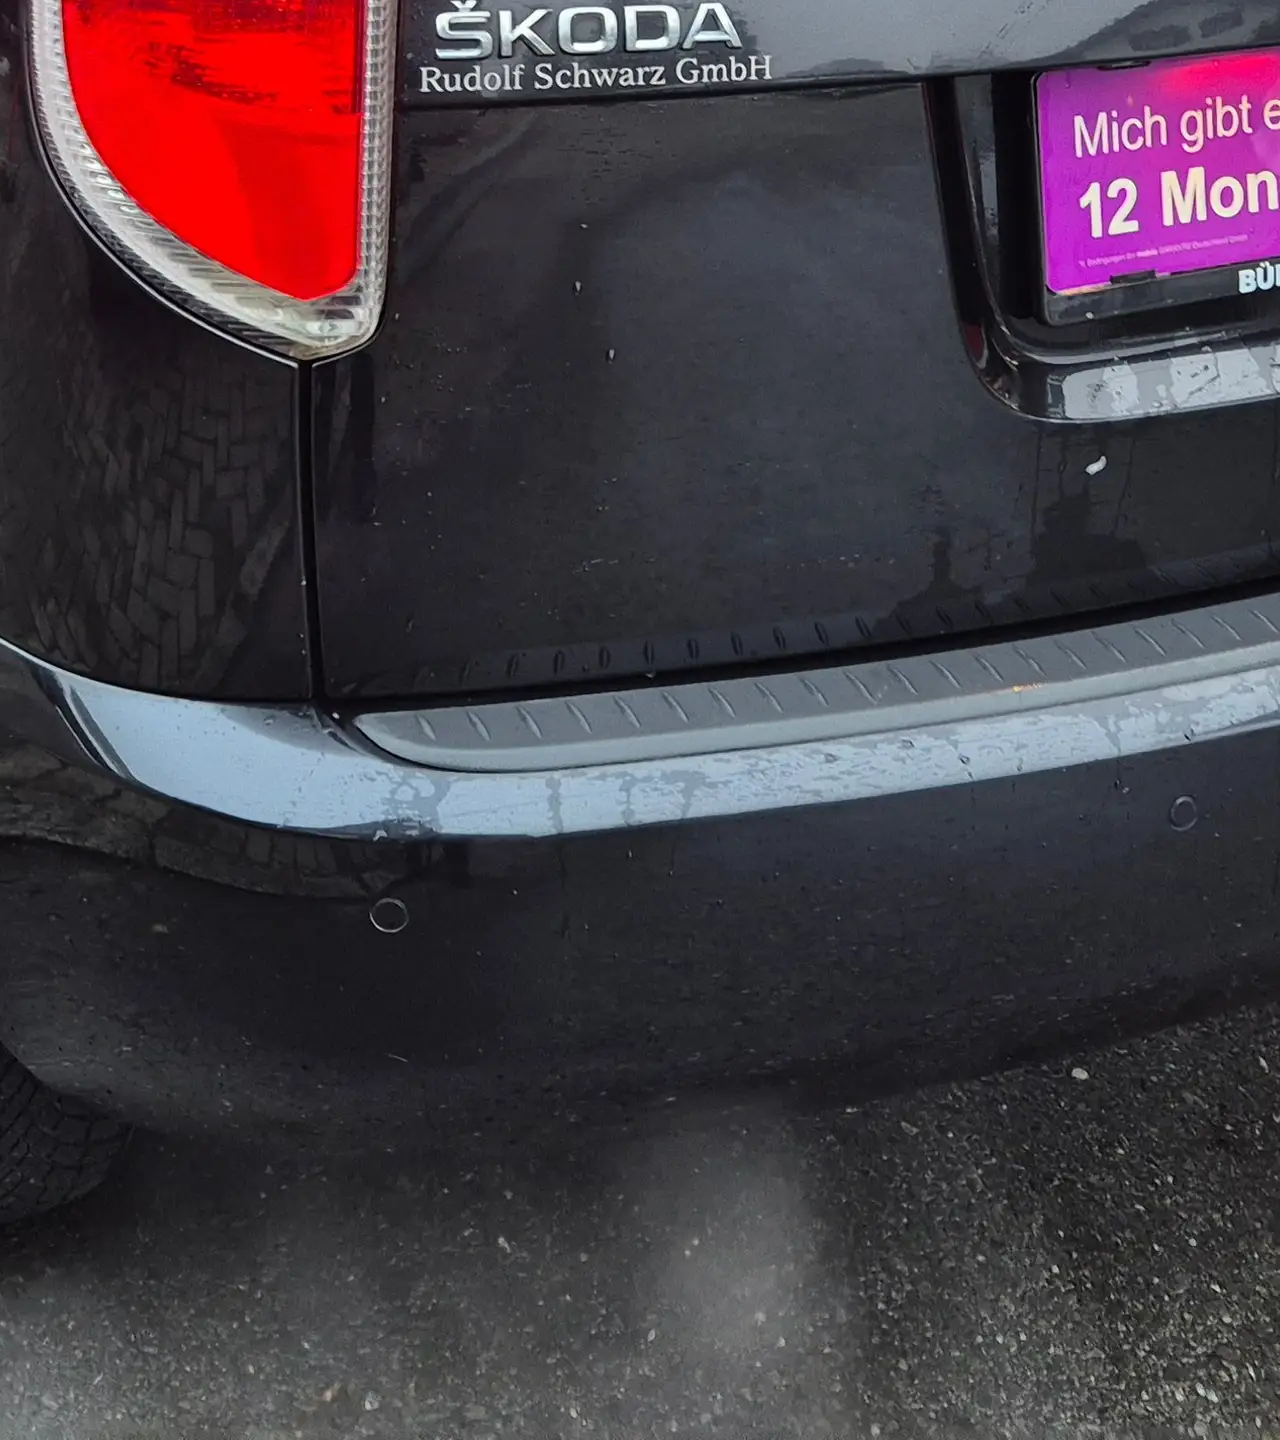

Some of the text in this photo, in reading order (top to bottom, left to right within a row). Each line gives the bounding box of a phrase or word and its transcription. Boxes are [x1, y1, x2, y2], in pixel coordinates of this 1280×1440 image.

[435, 0, 743, 60] ŠKODA
[420, 55, 773, 93] Rudolf Schwarz GmbH
[1073, 105, 1168, 158] Mich
[1179, 94, 1253, 153] gibt
[1079, 177, 1140, 239] 12
